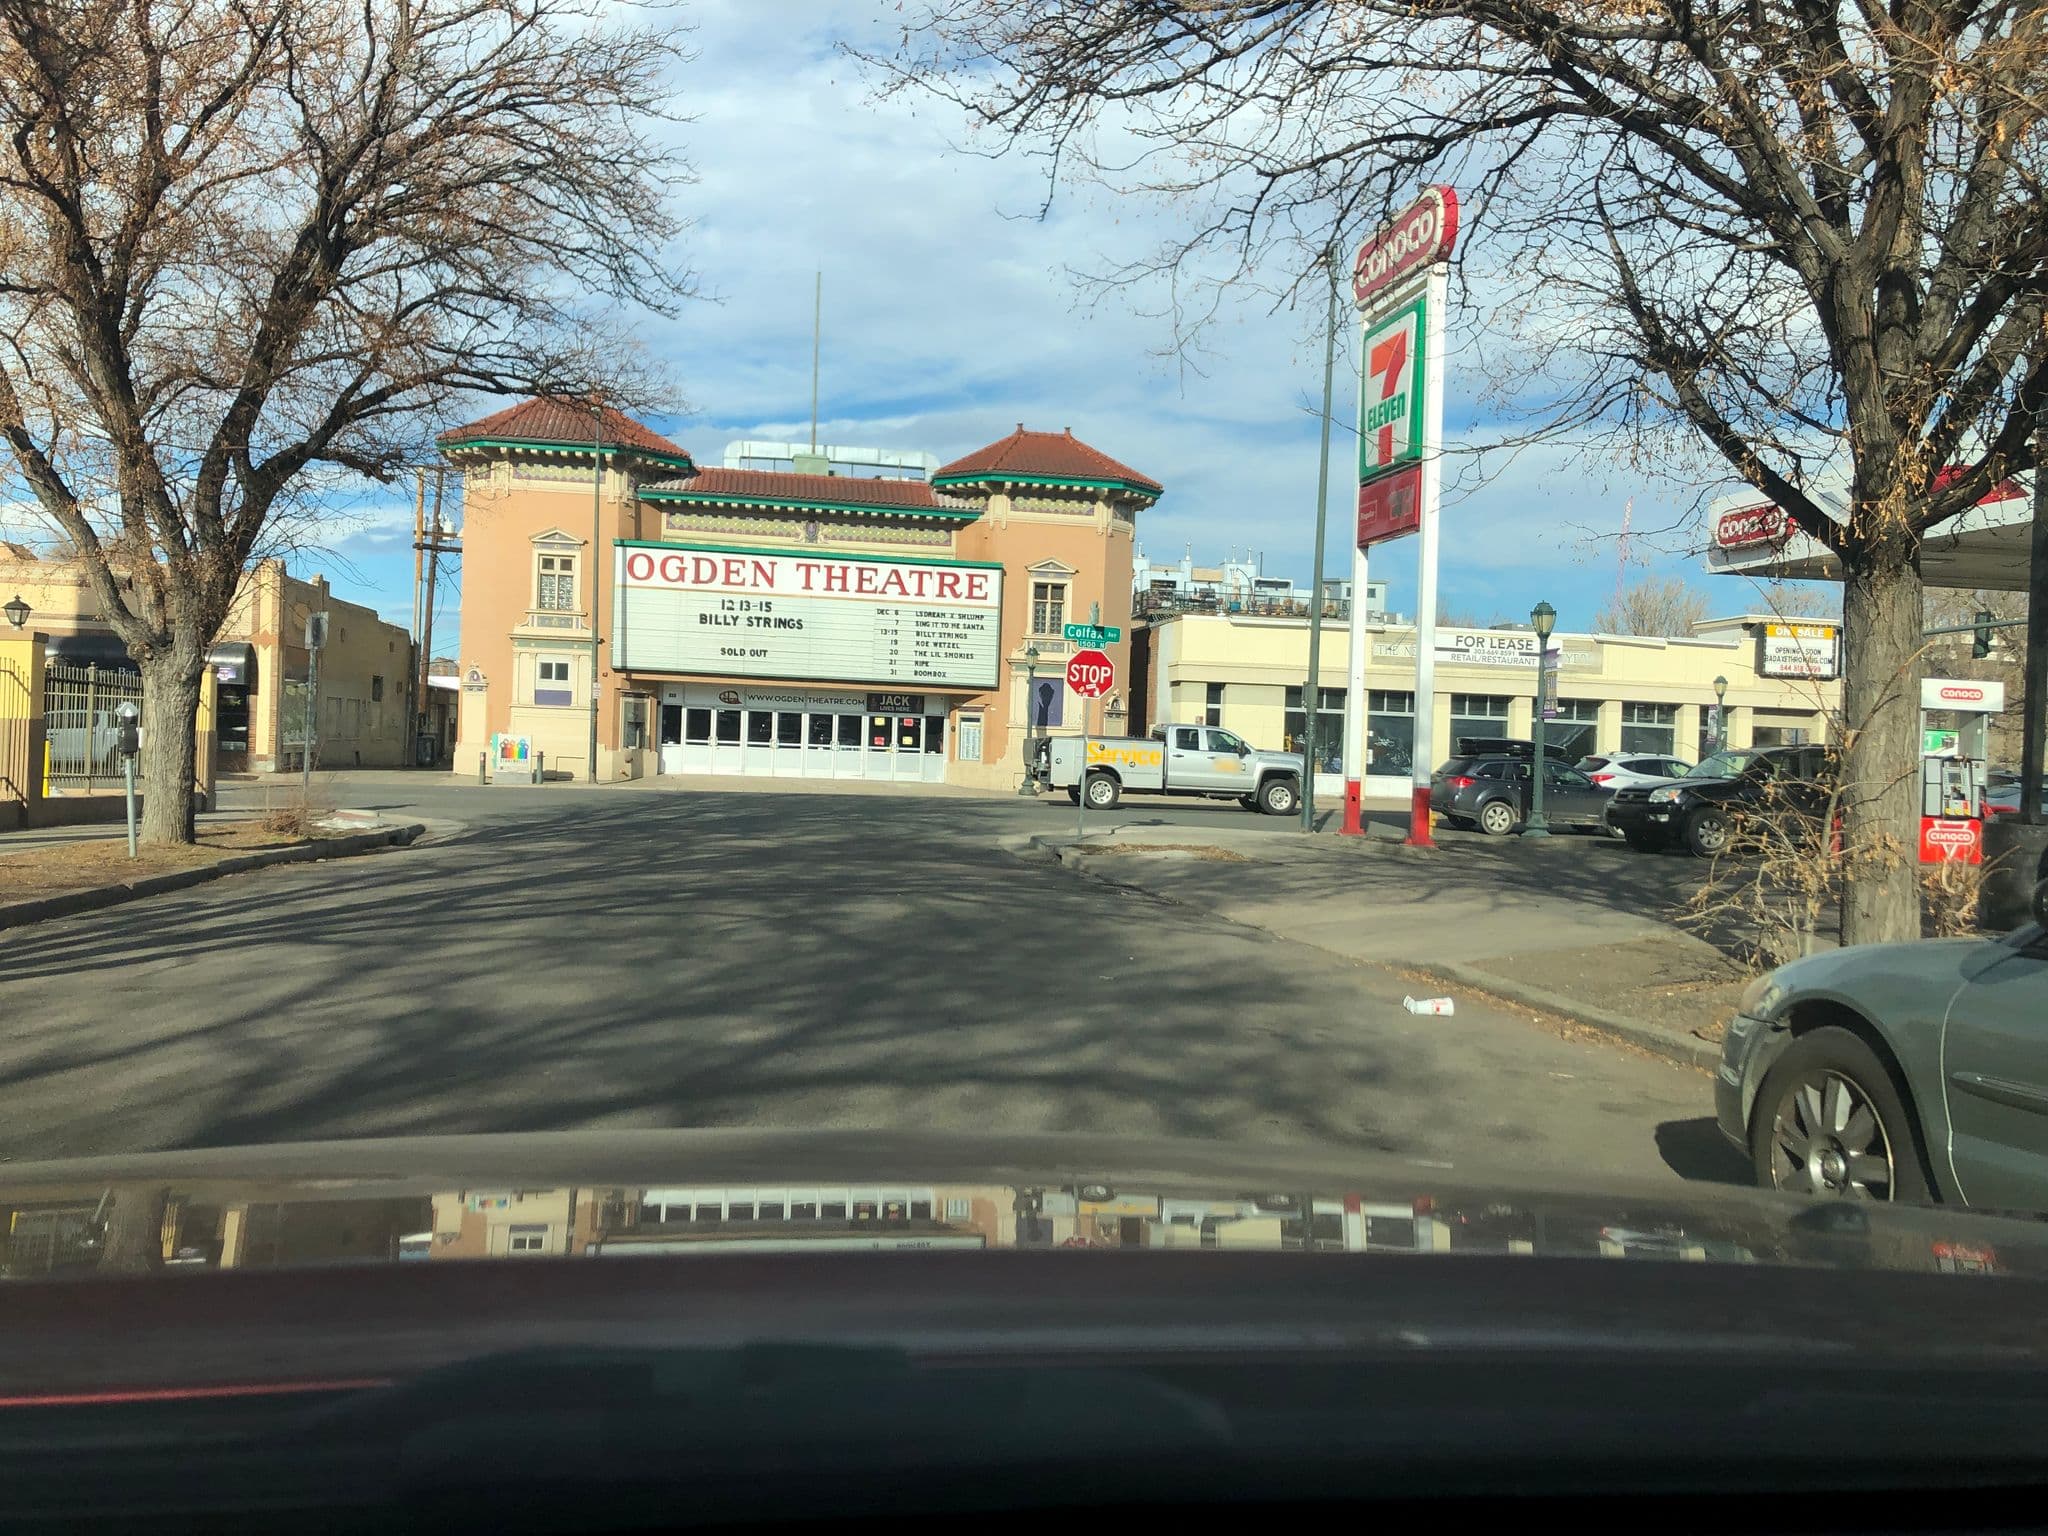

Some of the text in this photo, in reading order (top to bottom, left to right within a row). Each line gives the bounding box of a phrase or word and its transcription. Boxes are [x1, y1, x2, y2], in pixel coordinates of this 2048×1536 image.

[1370, 328, 1407, 466] 7
[627, 553, 989, 601] OGDEN THEATRE
[876, 608, 890, 616] DEC
[699, 613, 804, 630] BILLY STRINGS
[915, 620, 931, 628] SING
[962, 623, 985, 631] SANTA
[915, 630, 936, 638] BILLY
[938, 631, 968, 640] STRINGS
[1067, 625, 1104, 640] Colfax
[1775, 627, 1825, 637] ON SALE
[933, 641, 961, 649] WETZEL
[1079, 640, 1097, 648] 1500
[1456, 635, 1534, 650] FOR LEASE
[720, 647, 769, 658] SOLD OUT
[943, 651, 975, 660] SMOKIES
[1775, 646, 1822, 656] OPENING SOON
[1450, 653, 1537, 666] RETAIL/RESTAURANT
[913, 669, 947, 678] BOOMBOX
[1069, 664, 1112, 684] STOP
[879, 695, 911, 707] JACK
[1087, 741, 1161, 766] Service
